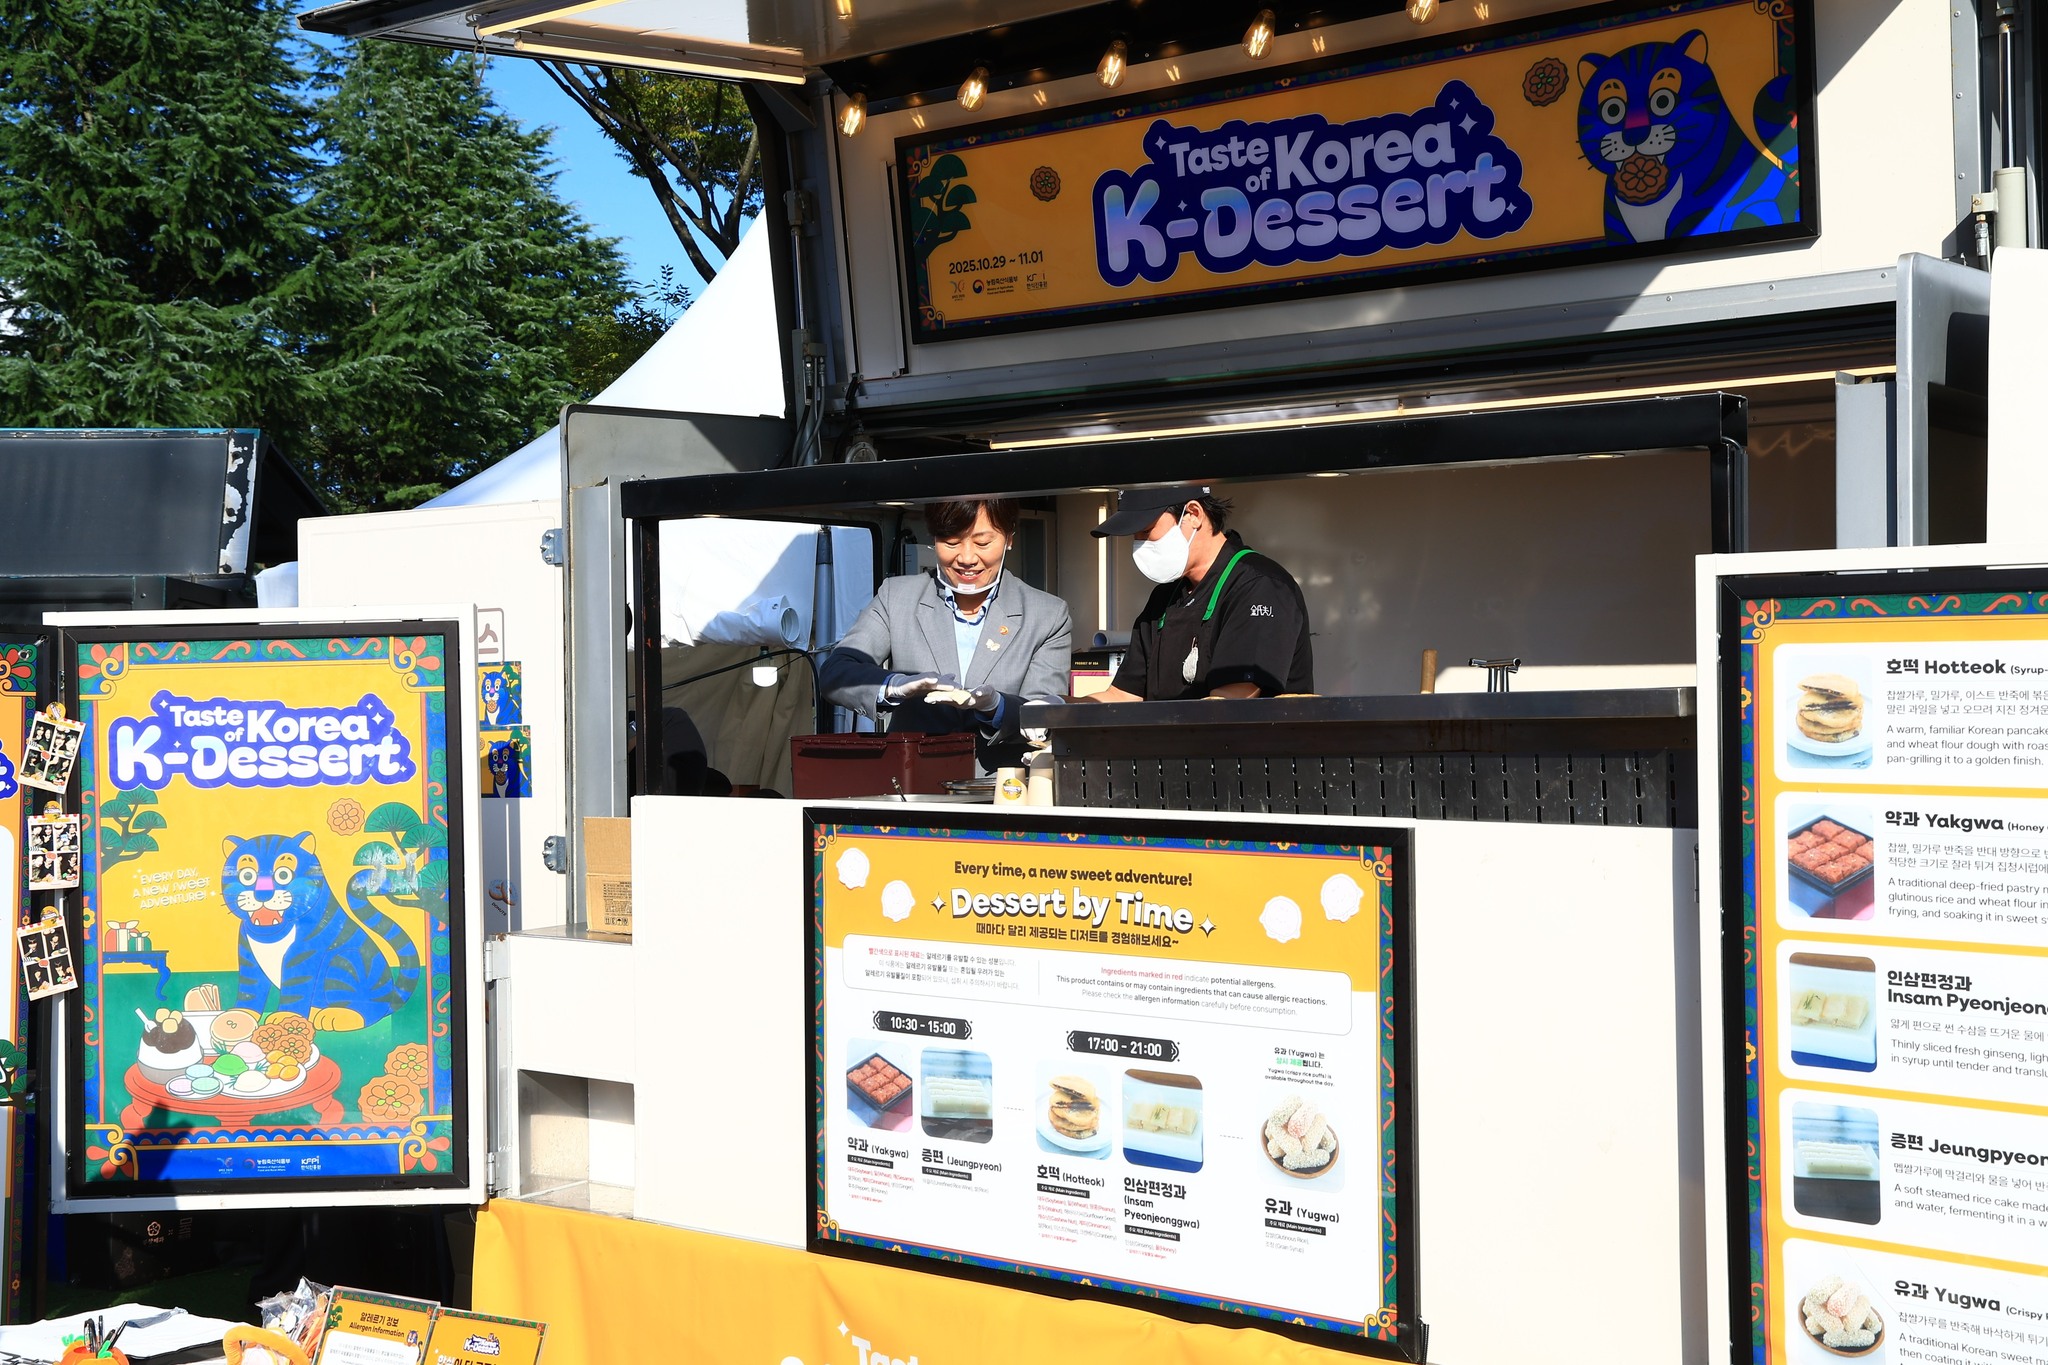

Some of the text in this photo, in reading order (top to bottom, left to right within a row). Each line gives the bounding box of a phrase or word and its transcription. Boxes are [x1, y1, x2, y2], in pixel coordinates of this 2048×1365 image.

[1168, 121, 1456, 193] Taste of Korea
[1104, 153, 1507, 273] K-Dessert
[949, 251, 1043, 274] 2025.10.29 11.01
[1886, 659, 2006, 674] 호떡 Hotteok
[170, 705, 370, 743] Taste of Korea
[1887, 725, 2004, 735] A warm, familiar Korean
[117, 725, 401, 782] K-Dessert
[1887, 740, 2024, 751] and wheat flour dough with
[1887, 755, 1941, 766] pan-grilling
[1954, 756, 1963, 764] to
[1975, 757, 2010, 766] golden
[2014, 757, 2044, 765] finish.
[1885, 811, 2044, 833] 약과 Yakgwa (Honey
[954, 861, 1192, 886] Every time, a new sweet adventure!
[1888, 878, 2039, 895] A traditional deep-fried pastry
[951, 886, 1194, 934] Dessert by Time
[1888, 892, 2037, 908] glutinous rice and wheat flour
[1888, 907, 2037, 924] frying, and soaking in sweet
[976, 923, 1005, 936] 때마다
[1008, 924, 1026, 938] 달리
[1029, 926, 1067, 940] 제공되는
[1070, 929, 1108, 943] 디저트를
[1101, 968, 1137, 978] Ingredients
[1139, 970, 1162, 978] marked
[1210, 976, 1240, 986] potential
[1242, 979, 1276, 989] allergens.
[1888, 971, 1972, 991] 인삼편정과
[1056, 976, 1069, 984] This
[1071, 977, 1096, 986] product
[1097, 978, 1124, 987] contains
[1134, 982, 1147, 990] may
[1148, 982, 1172, 992] contain
[1174, 984, 1212, 994] ingredients
[1214, 988, 1227, 996] that
[1242, 991, 1263, 999] cause
[1264, 992, 1290, 1002] allergic
[1292, 994, 1327, 1006] reactions.
[1134, 994, 1200, 1006] allergen information
[1888, 989, 1942, 1006] Insam
[890, 1016, 956, 1035] 10:30 15:00
[1088, 1036, 1162, 1056] 17:00 21:00
[1288, 1049, 1317, 1058] (Yugwa)
[1891, 1039, 2027, 1062] Thinly sliced fresh ginseng,
[1891, 1054, 2012, 1074] in syrup until tender and
[848, 1137, 909, 1158] 약과 (Yakgwa)
[1891, 1133, 1923, 1150] 증편
[922, 1148, 1002, 1172] 증편 (Jeungpyeon)
[1037, 1165, 1105, 1187] 호떡 (Hotteok)
[1124, 1177, 1186, 1199] 인삼편정과
[1894, 1184, 2019, 1208] A soft steamed rice cake
[1124, 1195, 1153, 1208] (Insam
[1265, 1198, 1339, 1223] 유과 (Yugwa)
[1124, 1209, 1200, 1229] Pyeonjeonggwa)
[1895, 1200, 2025, 1224] and water, fermenting in
[1894, 1280, 2042, 1320] 유과 Yugwa (Crispy
[361, 1312, 399, 1327] 알레르기 정보
[349, 1322, 404, 1338] Allergen Information
[1899, 1333, 2032, 1364] A traditional Korean sweet
[1900, 1348, 1922, 1360] then
